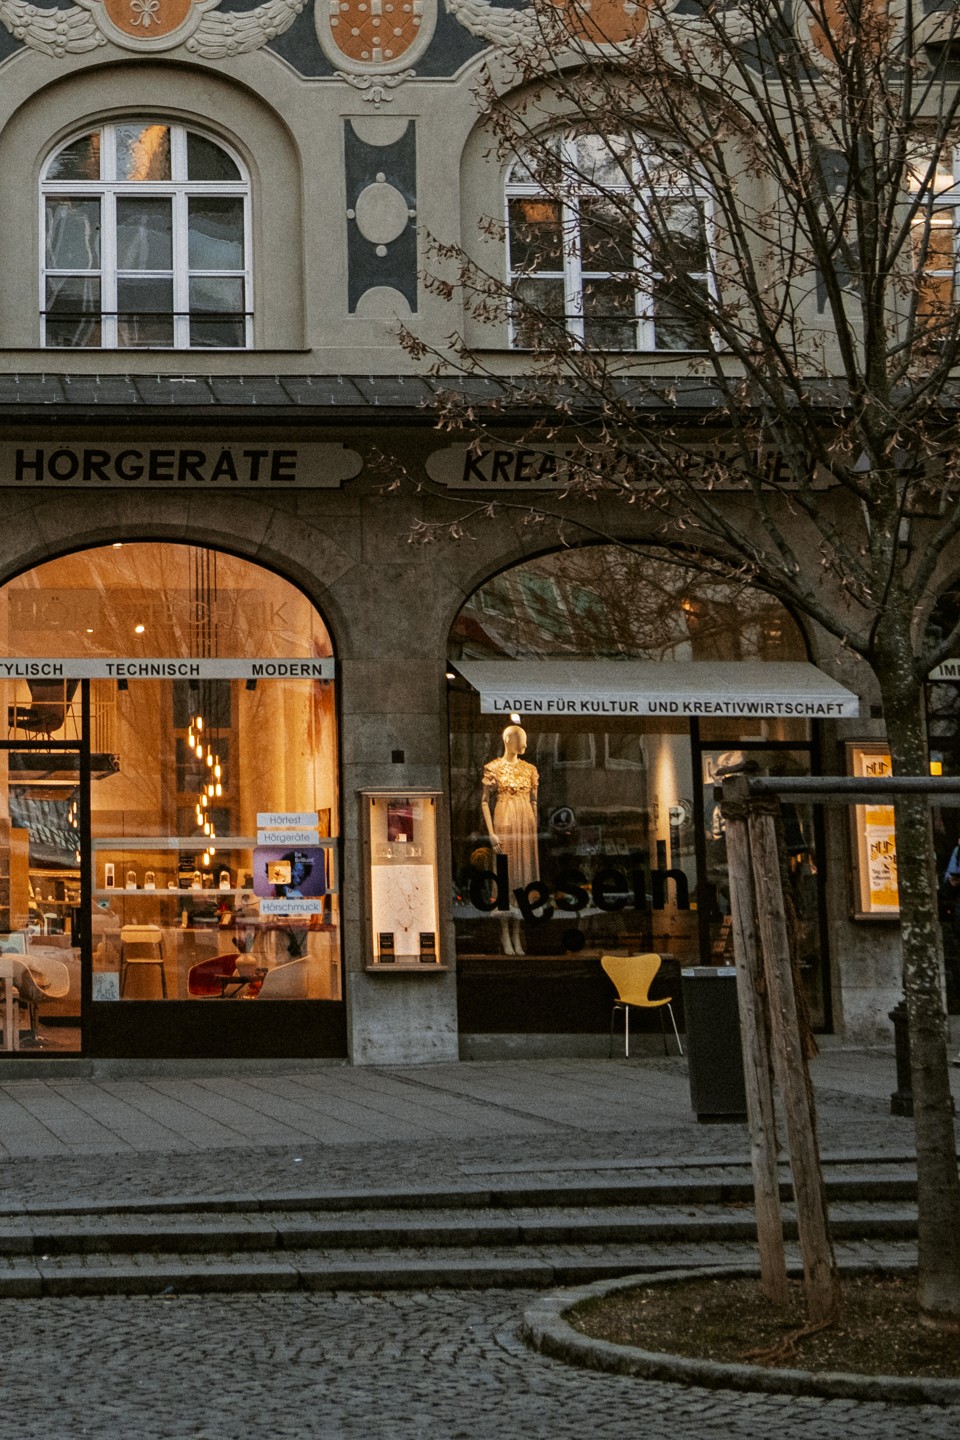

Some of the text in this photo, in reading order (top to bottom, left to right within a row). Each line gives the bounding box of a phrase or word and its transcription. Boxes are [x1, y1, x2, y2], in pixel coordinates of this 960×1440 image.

[15, 445, 297, 481] HÖRGERÄTE
[105, 663, 200, 676] TECHNISCH
[251, 663, 323, 676] MODERN
[494, 698, 844, 715] LADEN FÜR KULTUR UND KREATIVWIRTSCHAFT
[269, 815, 301, 825] Hörtest
[264, 833, 311, 844] Hörgeräte
[262, 902, 319, 912] Hörschmuck
